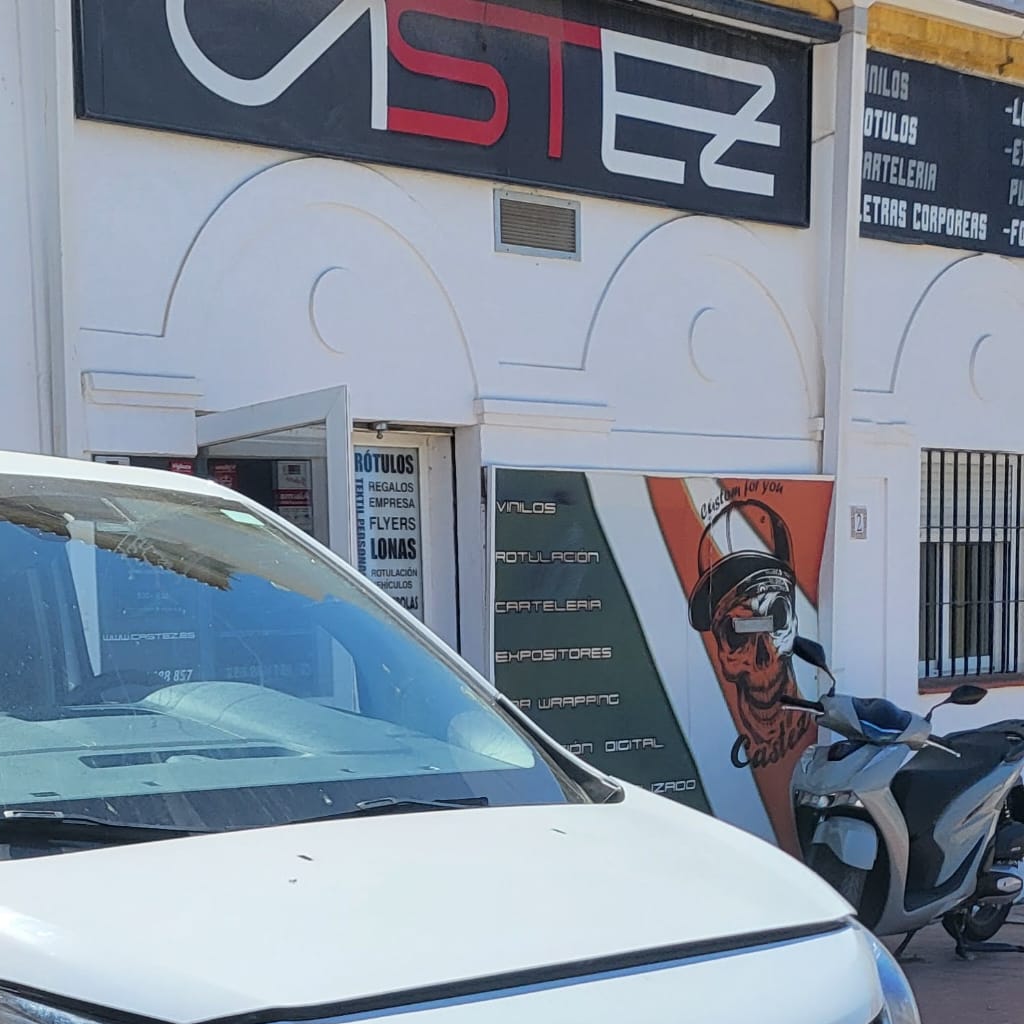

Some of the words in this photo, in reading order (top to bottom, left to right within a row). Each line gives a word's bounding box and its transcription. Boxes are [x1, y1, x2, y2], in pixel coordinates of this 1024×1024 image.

[912, 202, 988, 241] CORPOREAS
[354, 449, 414, 474] RÓTULOS
[368, 481, 414, 493] REGALOS
[761, 481, 784, 496] you
[369, 497, 416, 509] EMPRESA
[496, 501, 557, 514] VINILOS
[369, 516, 416, 531] FLYERS
[370, 537, 417, 560] LONAS
[371, 566, 418, 577] ROTULACIÓN
[495, 647, 612, 663] EXPOSITORES
[538, 694, 620, 710] WRAPPING
[605, 737, 664, 753] DIGITAL
